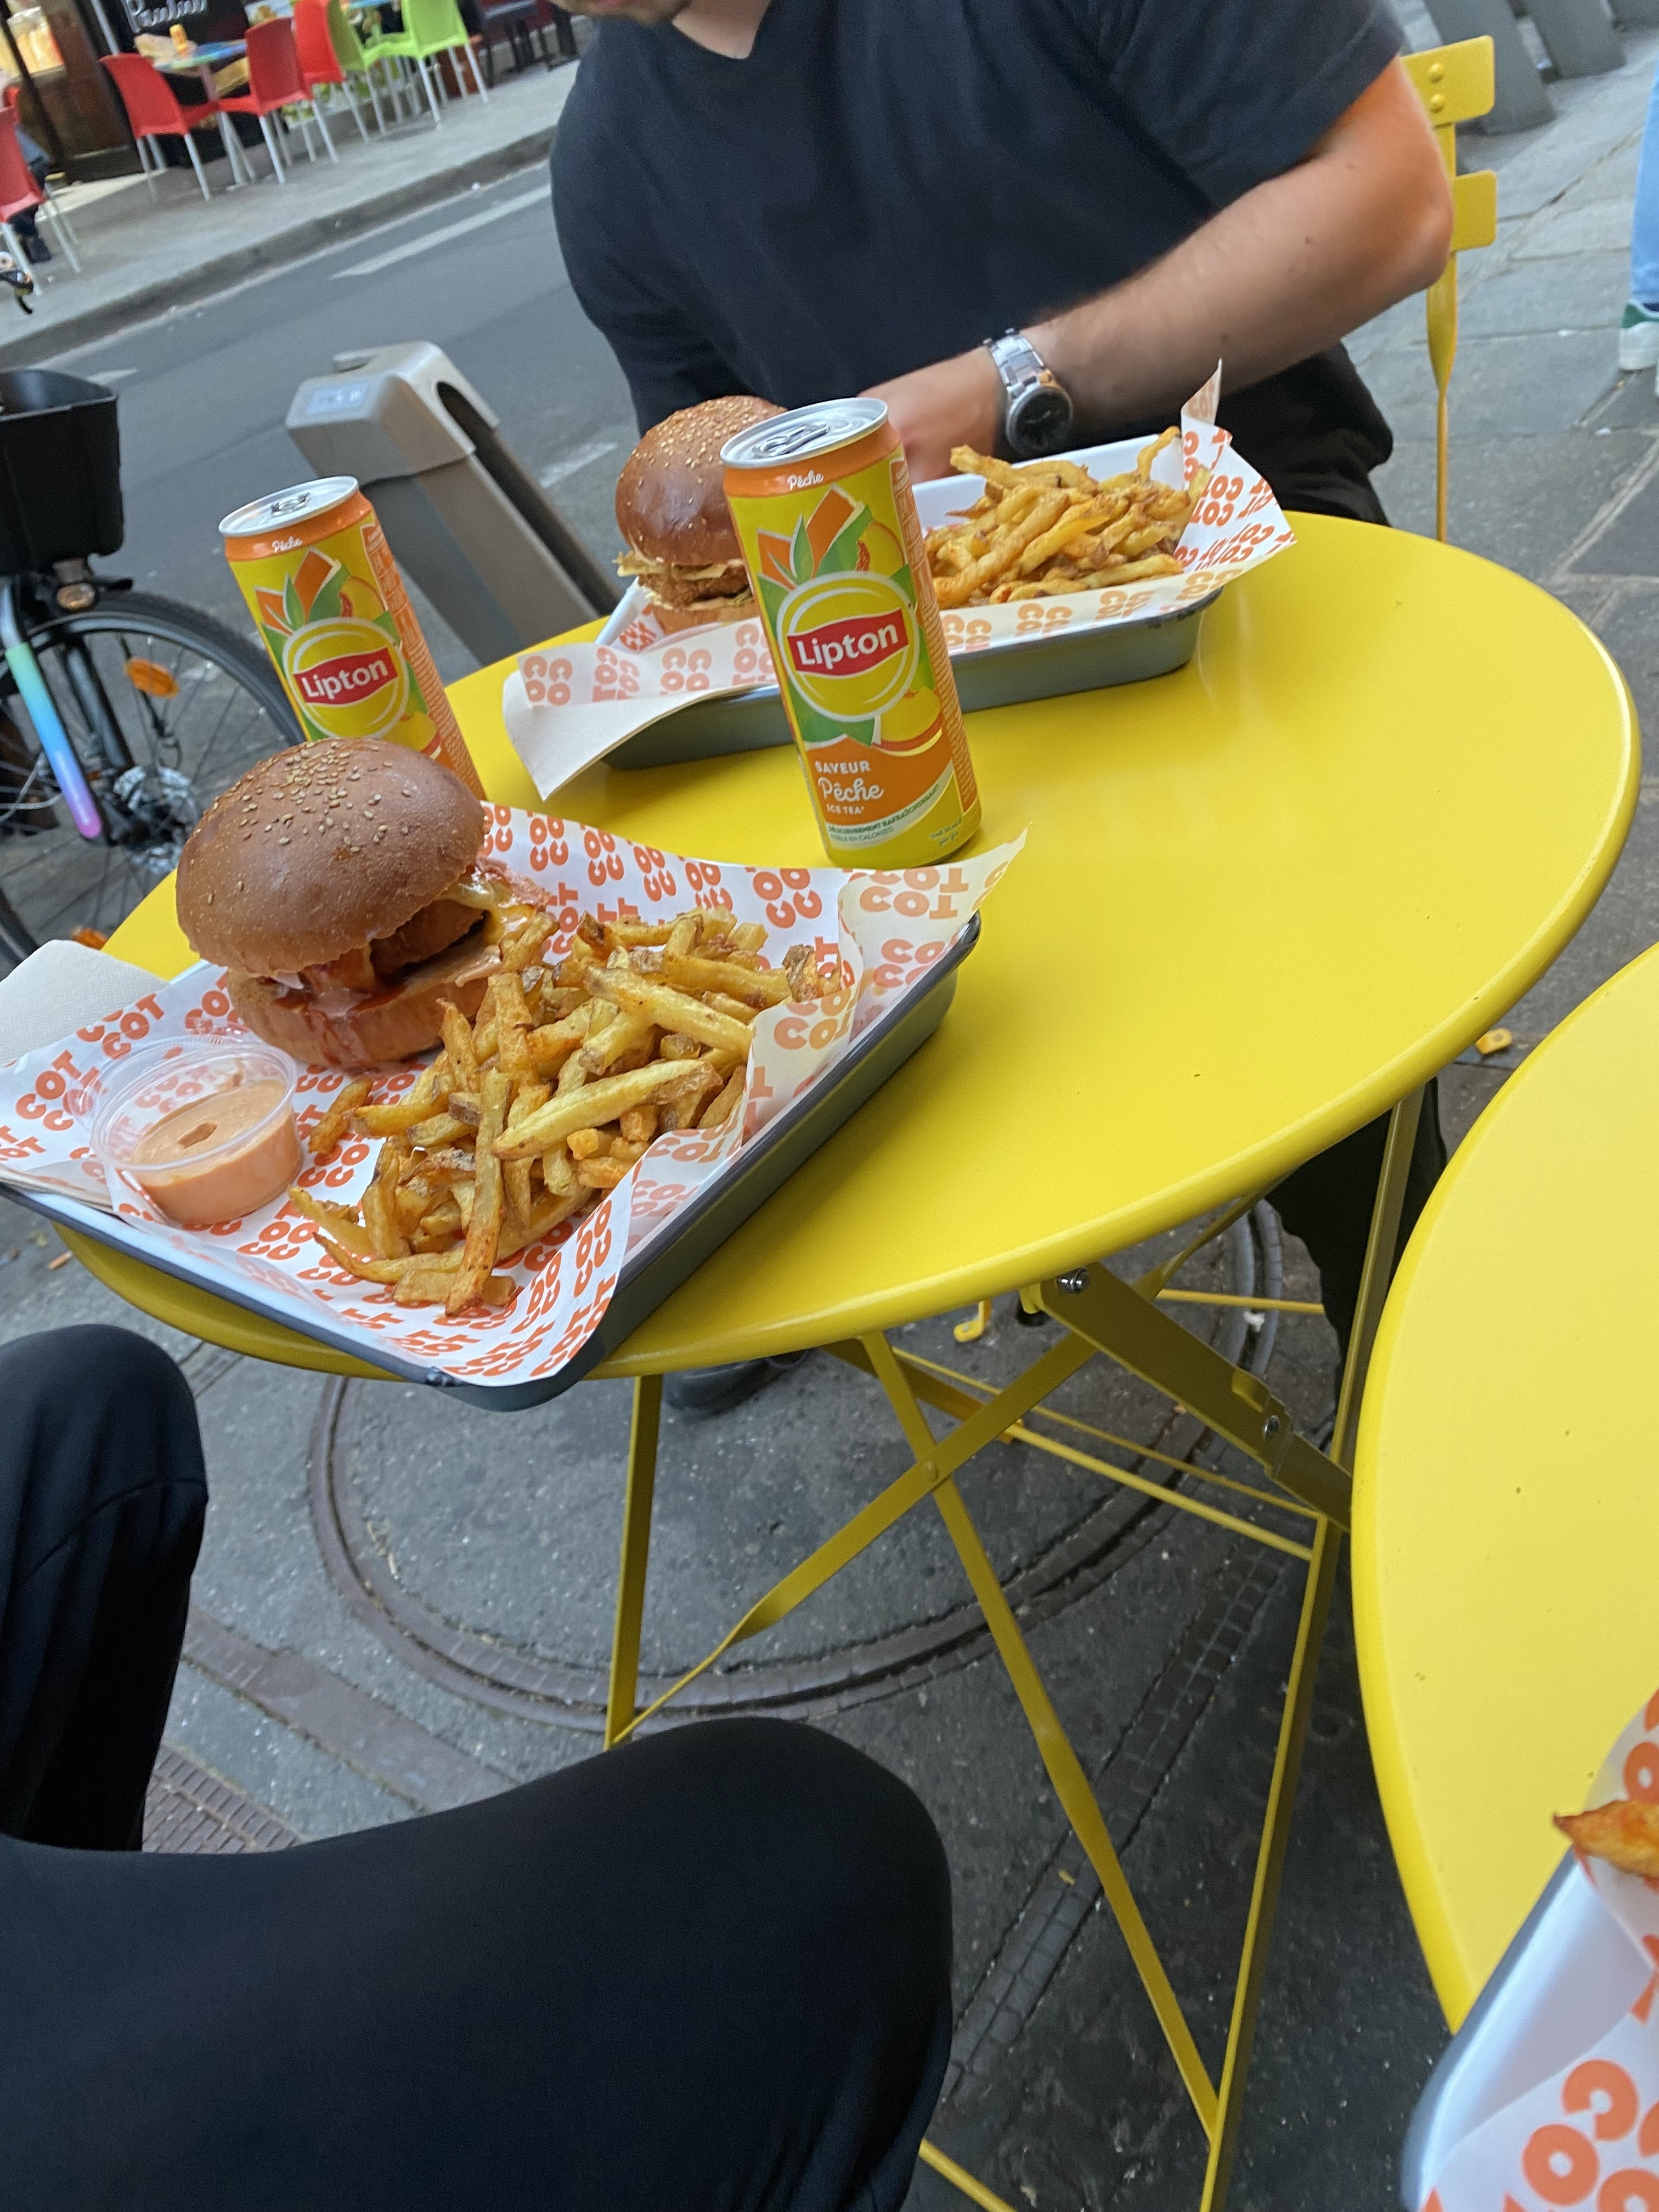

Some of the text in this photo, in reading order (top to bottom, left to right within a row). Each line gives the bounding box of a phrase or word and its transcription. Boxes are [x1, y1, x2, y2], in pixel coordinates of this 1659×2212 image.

[796, 624, 899, 670] Lipton
[301, 659, 389, 700] Lipton
[814, 760, 871, 774] SAVEUR
[817, 777, 884, 802] Pêche
[103, 992, 165, 1059] COT
[15, 1049, 82, 1120] COT
[442, 1341, 525, 1376] COT
[482, 1319, 557, 1377] COT
[529, 1302, 592, 1377] COT
